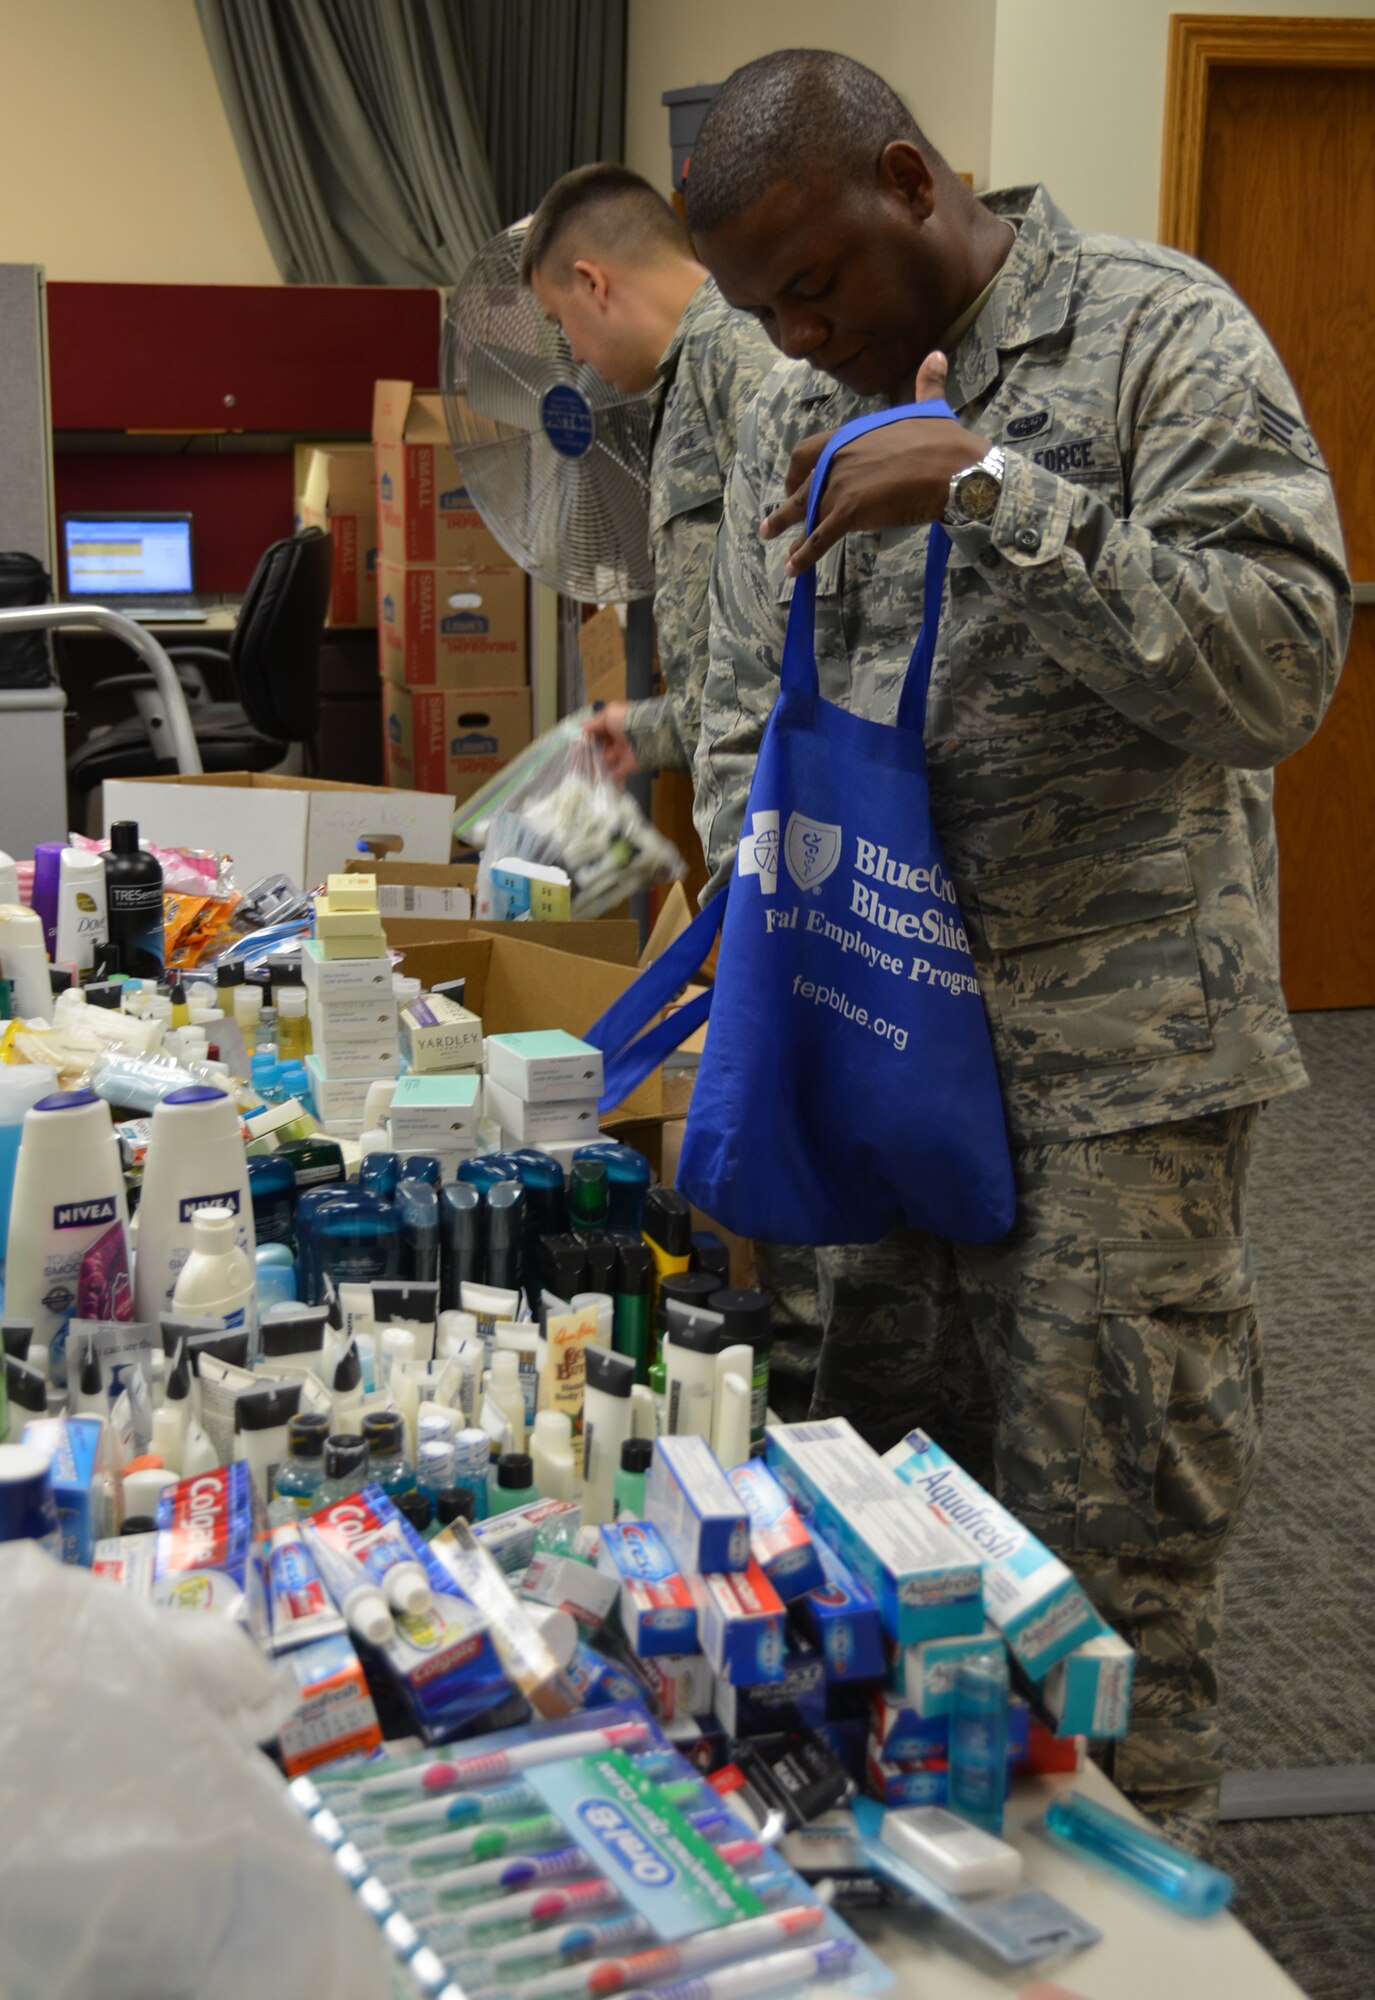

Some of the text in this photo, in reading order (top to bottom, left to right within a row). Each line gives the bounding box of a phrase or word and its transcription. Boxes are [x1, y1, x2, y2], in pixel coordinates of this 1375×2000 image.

[417, 448, 432, 509] SMALL
[1033, 440, 1095, 472] FORCE
[342, 519, 355, 576] SMALL
[418, 574, 433, 634] SMALL
[429, 697, 443, 755] SMALL
[854, 836, 955, 905] BlueCro
[77, 916, 106, 933] Dove
[805, 908, 903, 976] Employee
[850, 880, 971, 955] BlueShie
[418, 1033, 479, 1051] YARDLEY
[792, 975, 910, 1051] fepblue.org
[58, 1203, 114, 1225] NIVEA
[180, 1476, 222, 1563] Colgate
[915, 1469, 1021, 1560] Aquafresh
[282, 1544, 300, 1588] Crest
[621, 1525, 651, 1578] Crest
[904, 1571, 979, 1596] Aquafresh
[412, 1638, 477, 1681] Colgate
[584, 1804, 668, 1882] Oral-B
